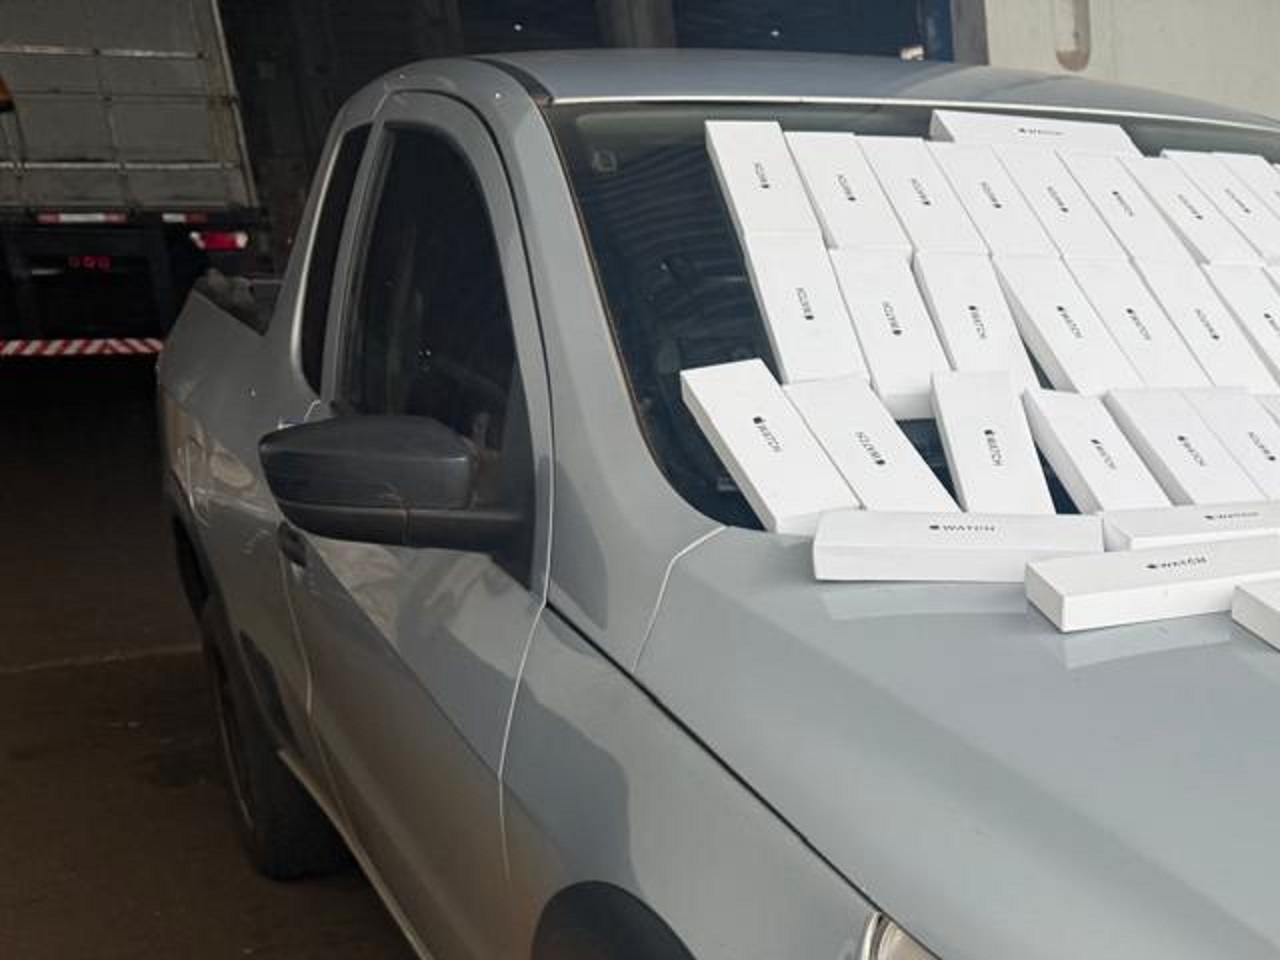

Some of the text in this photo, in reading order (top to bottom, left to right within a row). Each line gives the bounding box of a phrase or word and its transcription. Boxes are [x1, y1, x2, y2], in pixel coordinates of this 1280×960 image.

[756, 425, 783, 453] WATCH
[987, 437, 1002, 466] WATCH
[942, 524, 996, 533] WATCH
[1160, 556, 1207, 568] WATCH
